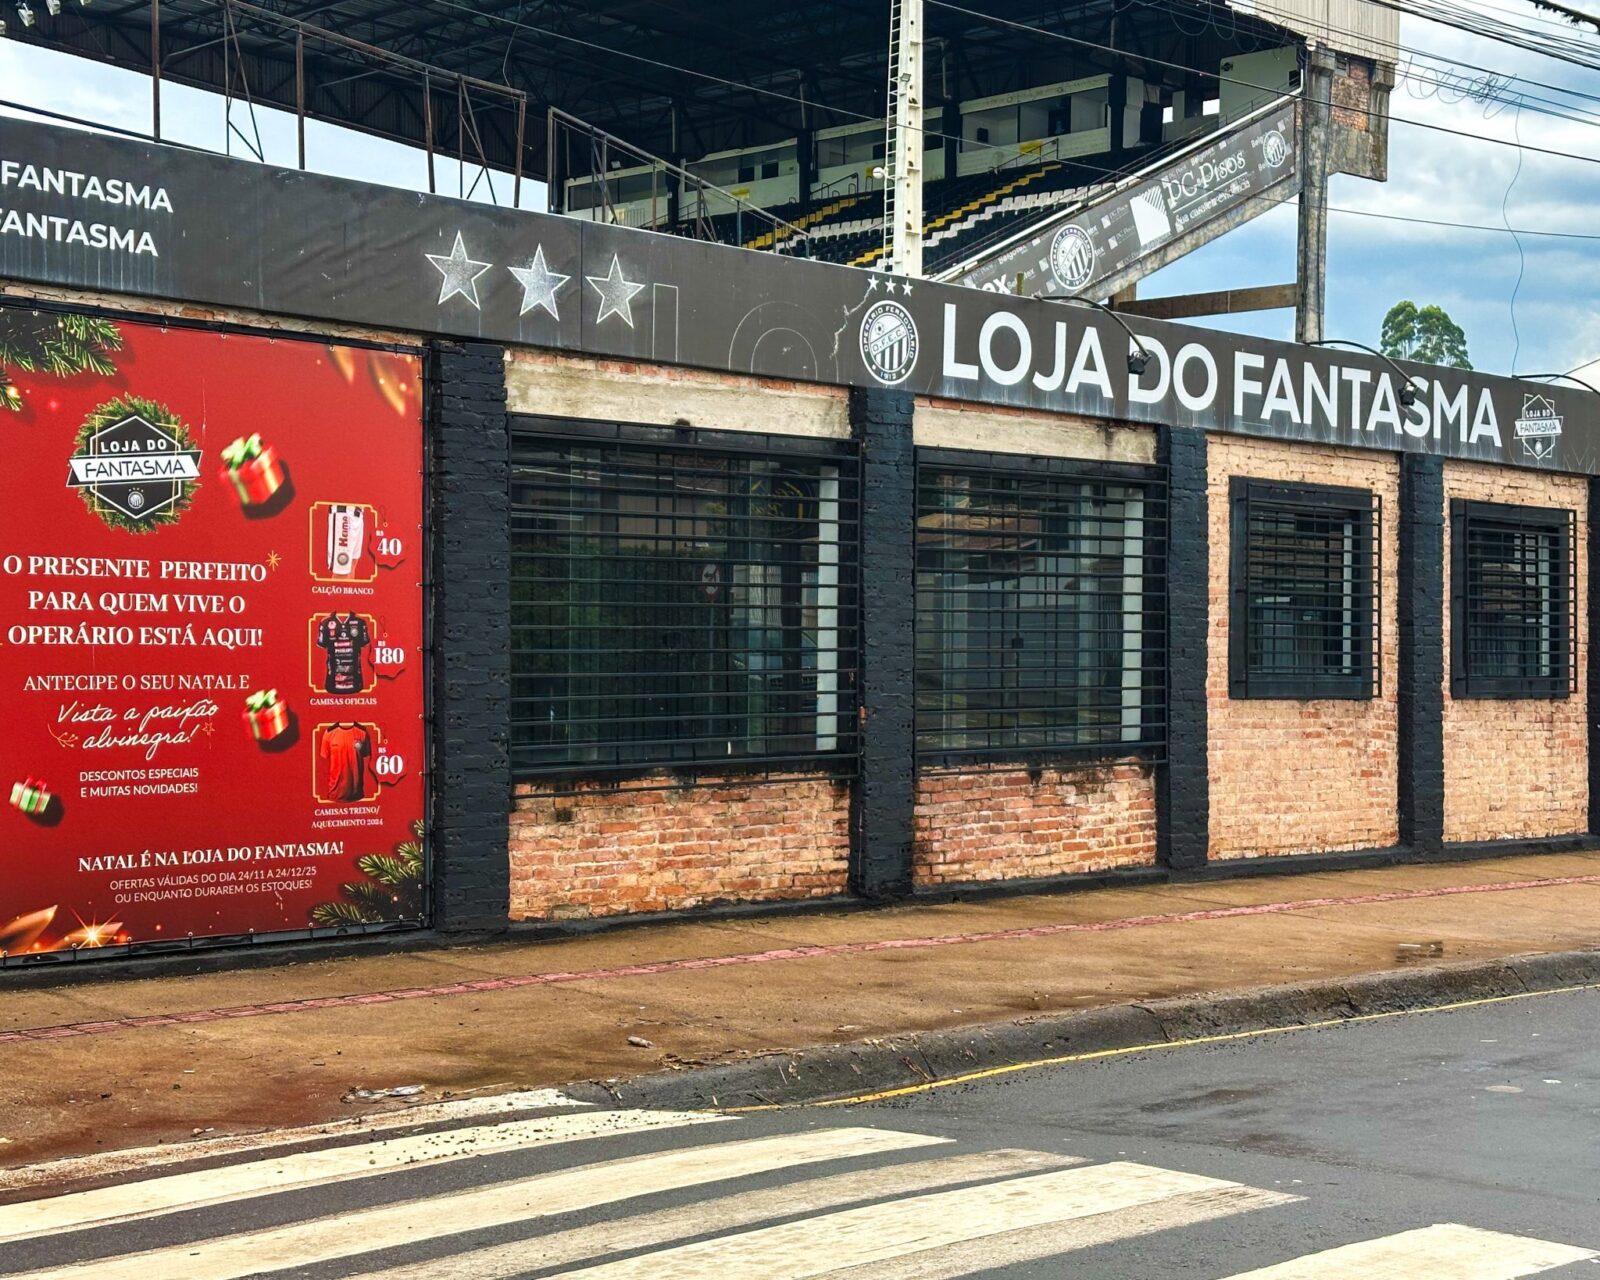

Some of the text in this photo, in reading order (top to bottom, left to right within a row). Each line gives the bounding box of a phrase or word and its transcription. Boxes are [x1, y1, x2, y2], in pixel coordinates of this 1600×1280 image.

[1198, 152, 1246, 188] Pisos
[1, 160, 174, 213] FANTASMA
[0, 207, 159, 257] ANTASMA
[942, 303, 1503, 448] LOJA DO FANTASMA
[1525, 409, 1551, 418] LOJA DO
[1520, 422, 1557, 433] FANTASMA
[101, 438, 168, 453] LOJA DO
[84, 459, 186, 478] FANTASMA
[377, 538, 402, 556] 40
[3, 555, 267, 582] O PRESENTE PERFEITO
[311, 585, 374, 596] CALÇÃO BRANCO
[28, 590, 246, 615] PARA QUEM VIVE O
[8, 621, 263, 650] OPERÁRIO ESTÁ AQUI!
[374, 647, 404, 665] 180
[23, 674, 250, 691] ANTECIPE O SEU NATAL E
[310, 697, 377, 706] CAMISAS OFICIAIS
[57, 698, 219, 733] Vista a paixão
[82, 723, 200, 761] alvinegra!
[79, 767, 199, 782] DESCONTOS ESPECIAIS
[375, 754, 403, 775] 60
[80, 783, 198, 798] E MUITAS NOVIDADES!
[314, 805, 380, 816] CAMISAS TREINO/
[311, 818, 366, 829] AQUECIMENTO
[78, 841, 344, 872] NATAL É NA LOJA DO FANTASMA!
[109, 866, 317, 891] OFERTAS VÁLIDAS DO DIA 24/11 A 24/12/25
[114, 879, 313, 904] OU ENQUANTO DURAREM OS ESTOQUES!
